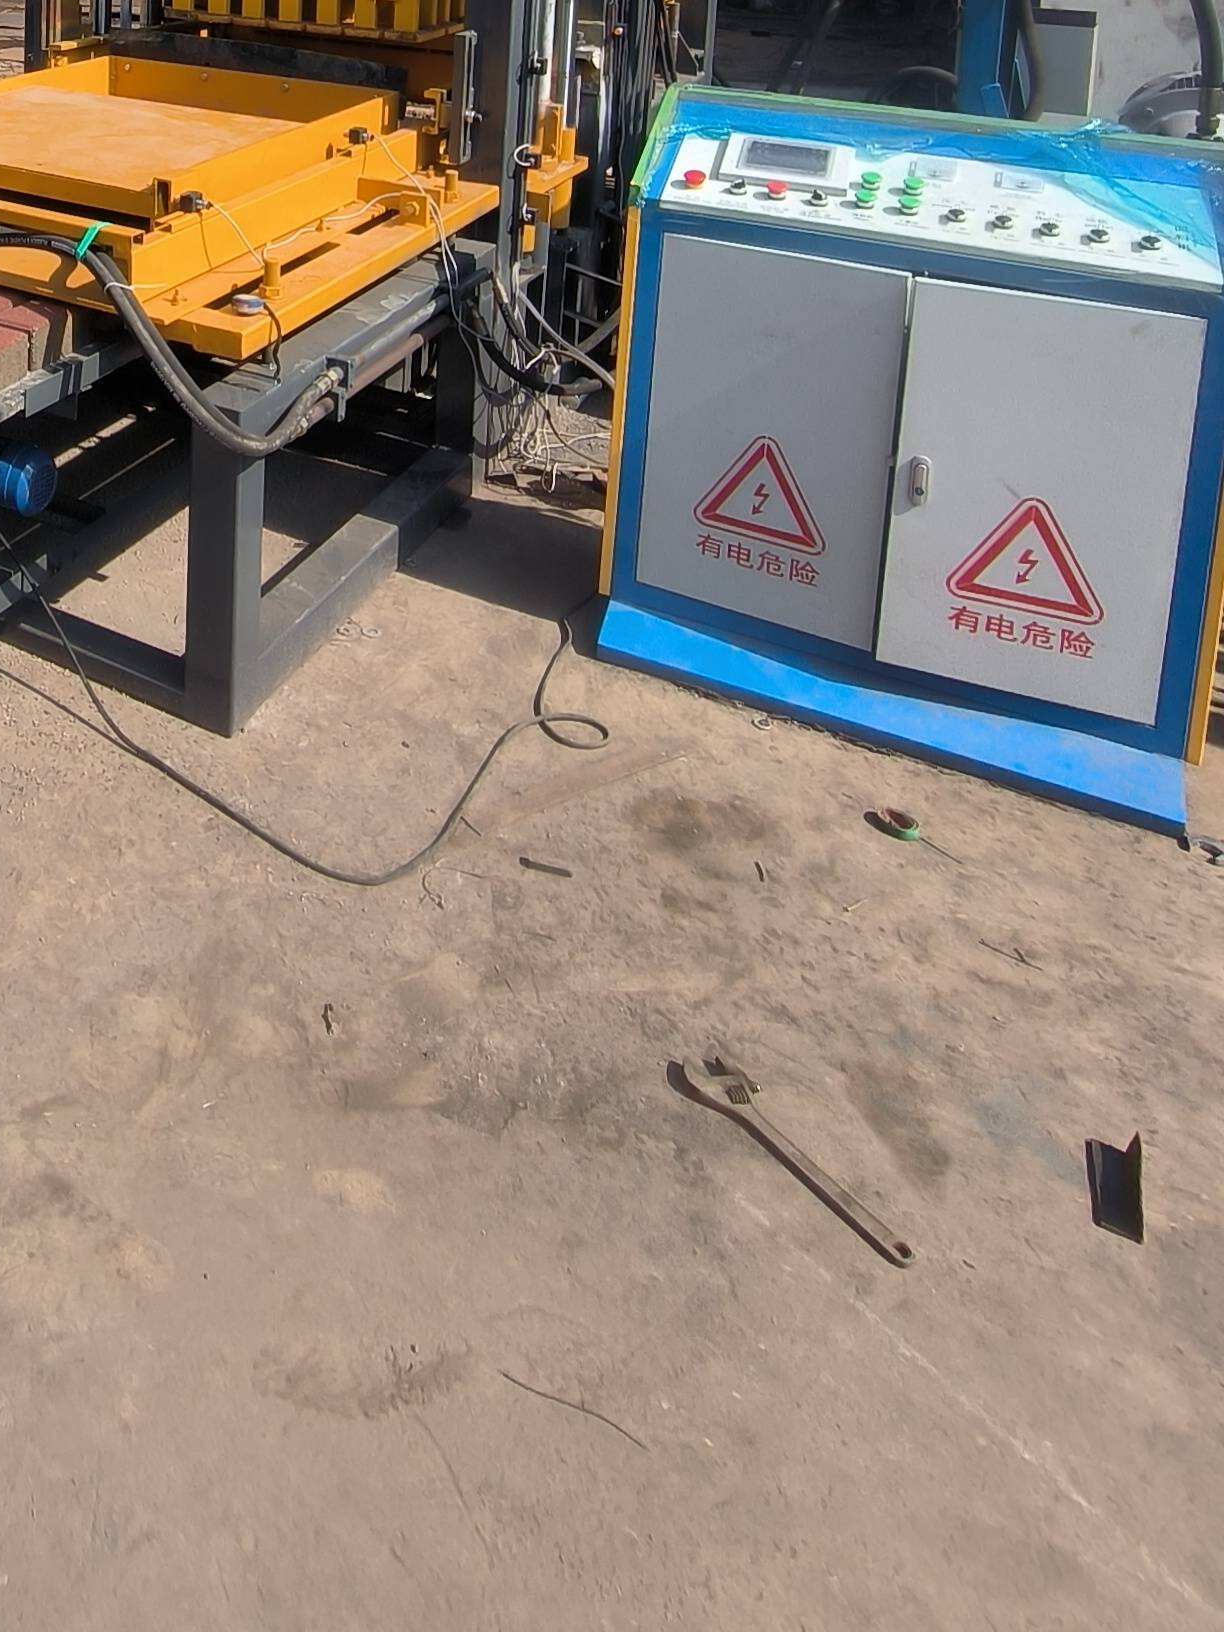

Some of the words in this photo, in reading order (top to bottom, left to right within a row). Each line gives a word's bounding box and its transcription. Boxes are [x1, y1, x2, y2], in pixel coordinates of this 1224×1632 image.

[696, 533, 820, 588] 有电危险
[948, 606, 1095, 658] 有电危险
